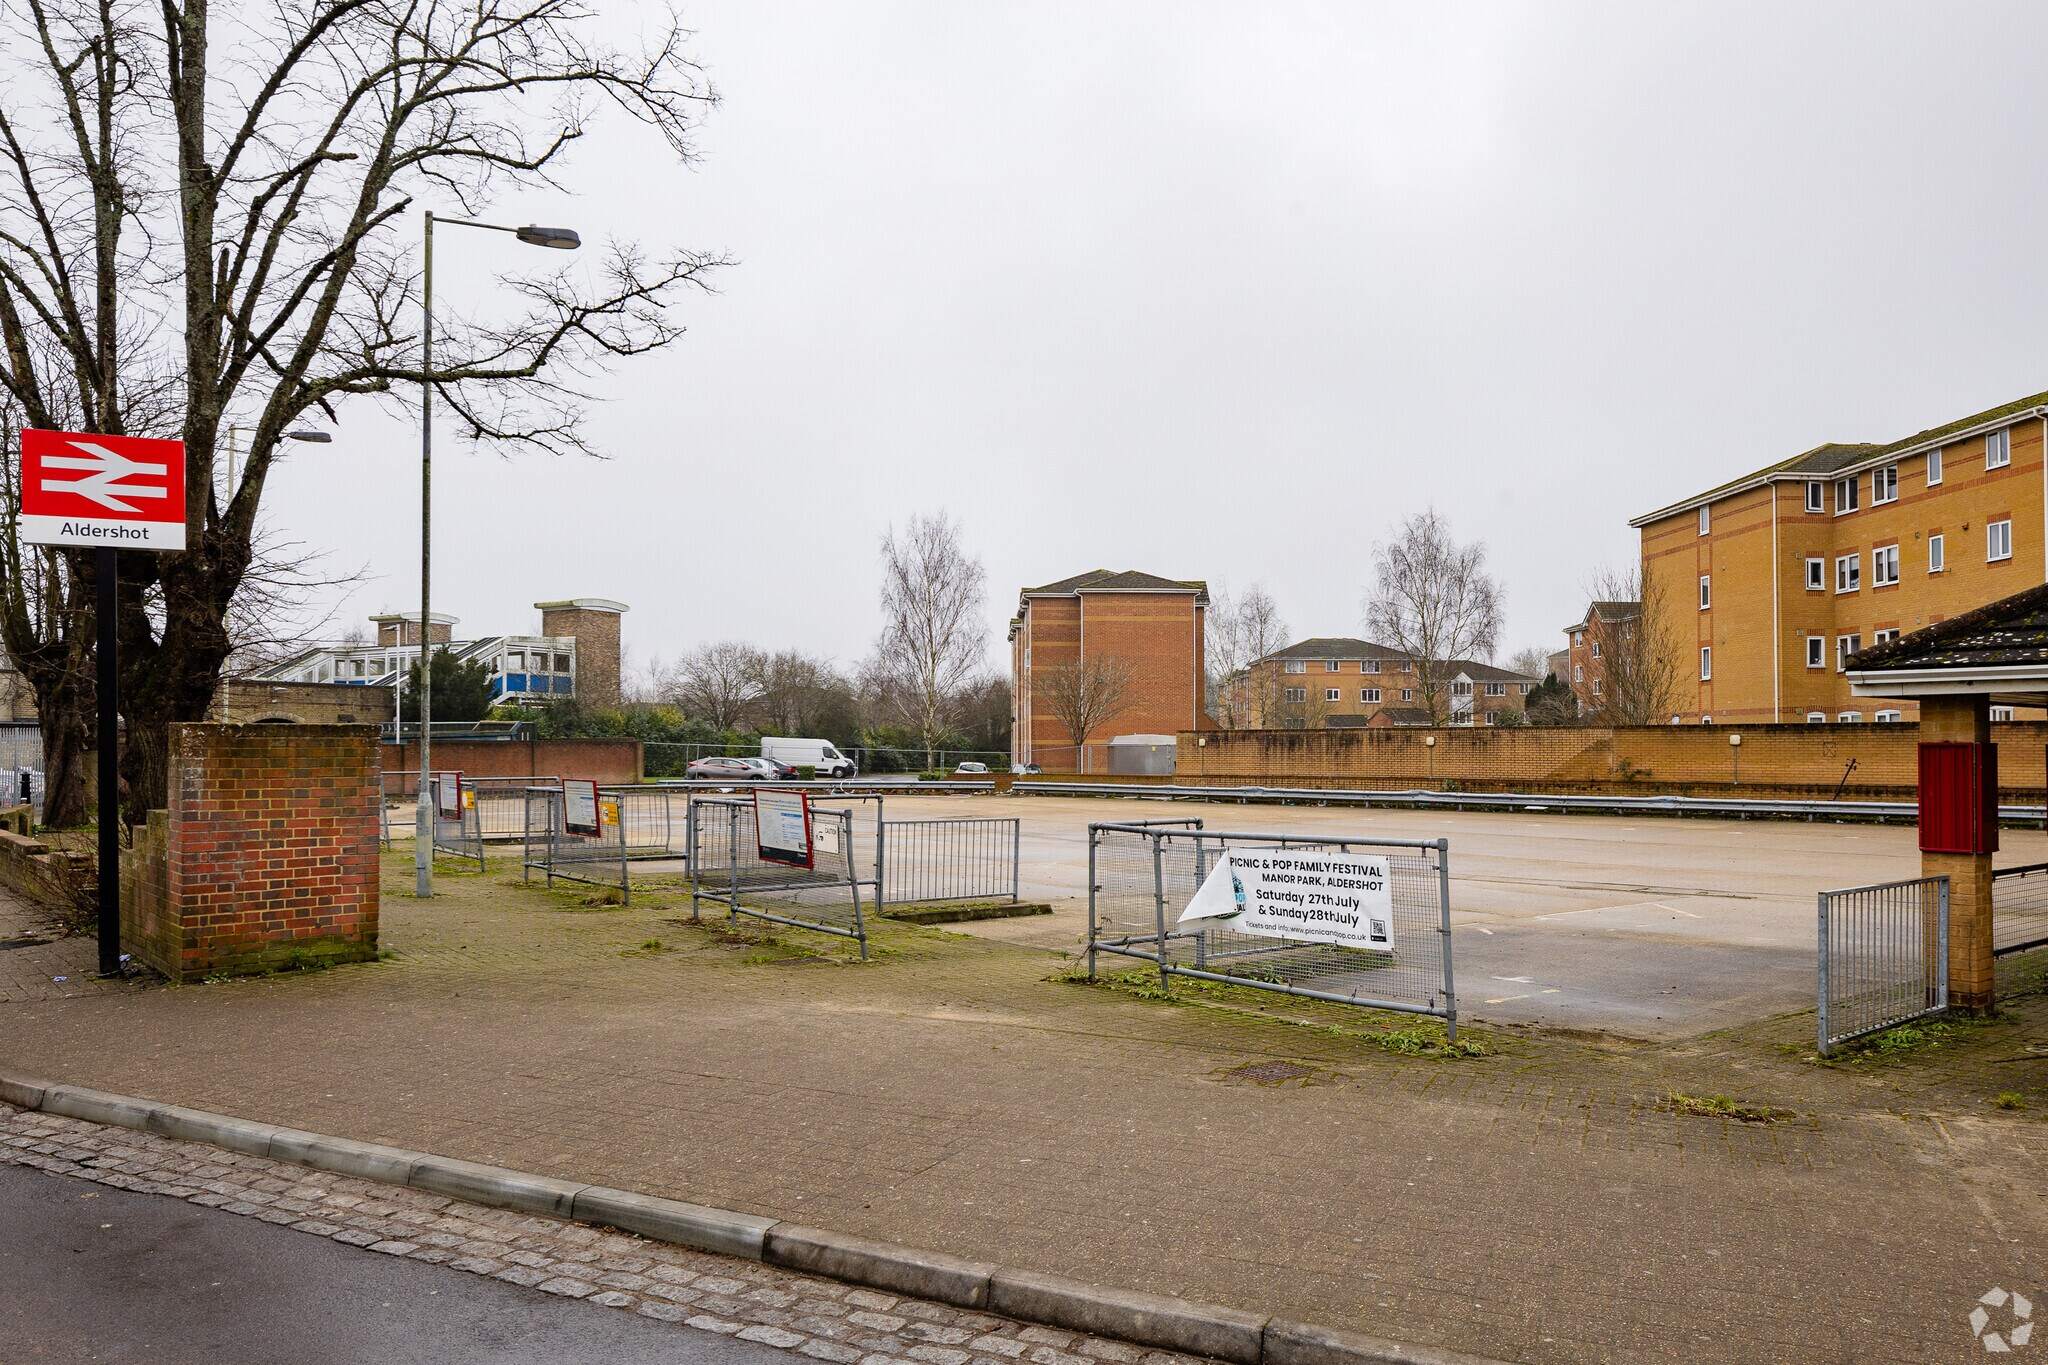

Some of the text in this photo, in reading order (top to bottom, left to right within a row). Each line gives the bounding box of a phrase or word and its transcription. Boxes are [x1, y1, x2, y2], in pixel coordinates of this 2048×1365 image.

[60, 522, 150, 540] Aldershot
[1229, 857, 1383, 877] PICNIC & POP FAMILY FESTIVAL
[1262, 873, 1383, 891] MANOR PARK, ALDERSHOT
[1256, 889, 1360, 911] Saturday 27th July
[1258, 905, 1267, 915] &
[1269, 905, 1309, 922] Sunday
[1245, 921, 1263, 929] Tickets
